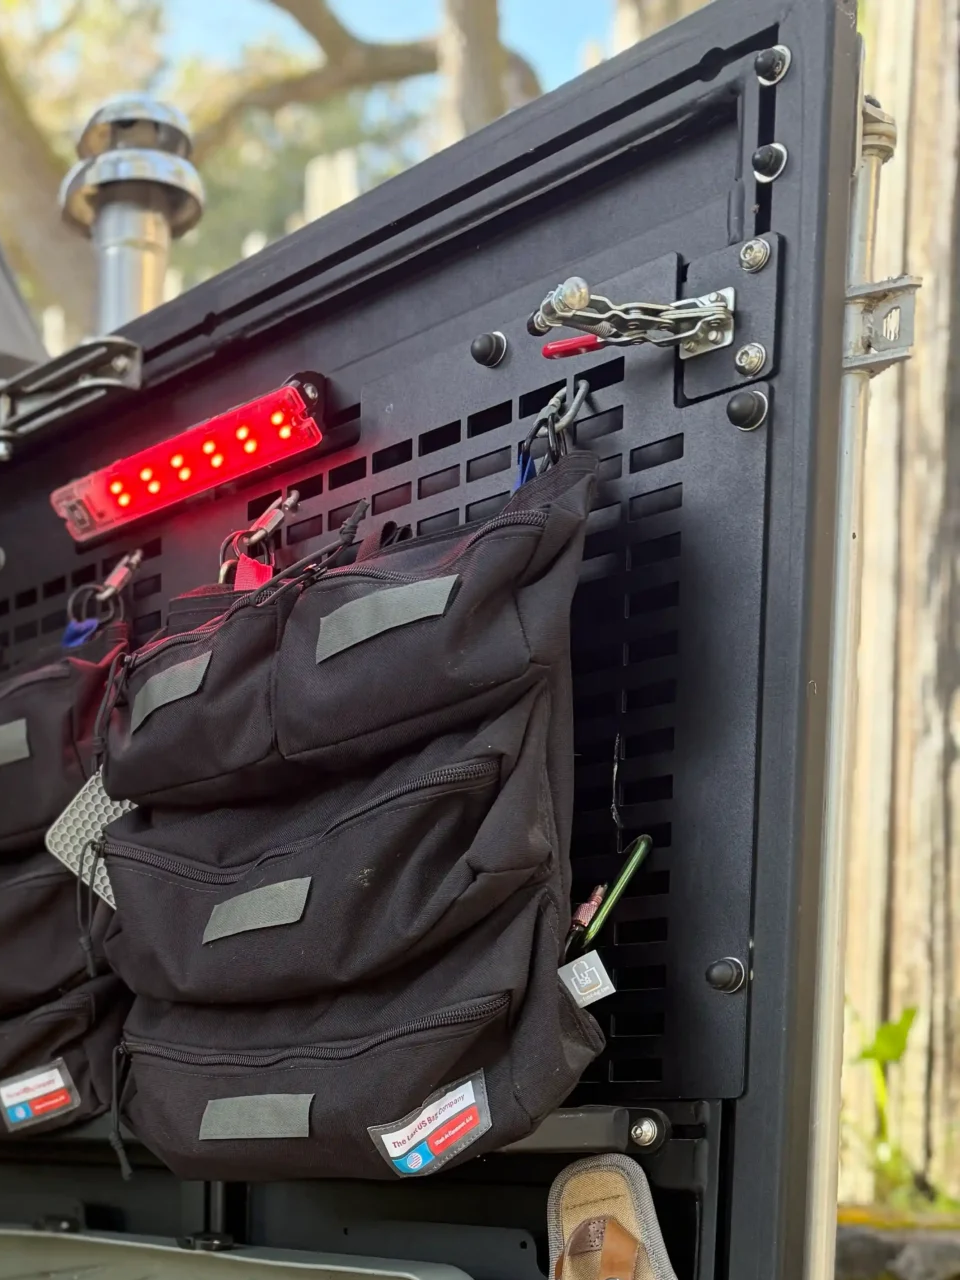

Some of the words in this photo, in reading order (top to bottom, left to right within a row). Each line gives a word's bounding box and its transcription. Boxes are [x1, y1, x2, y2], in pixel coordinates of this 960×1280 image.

[392, 1139, 407, 1149] The
[418, 1120, 428, 1131] US
[427, 1113, 440, 1124] Bag
[438, 1094, 465, 1115] Company
